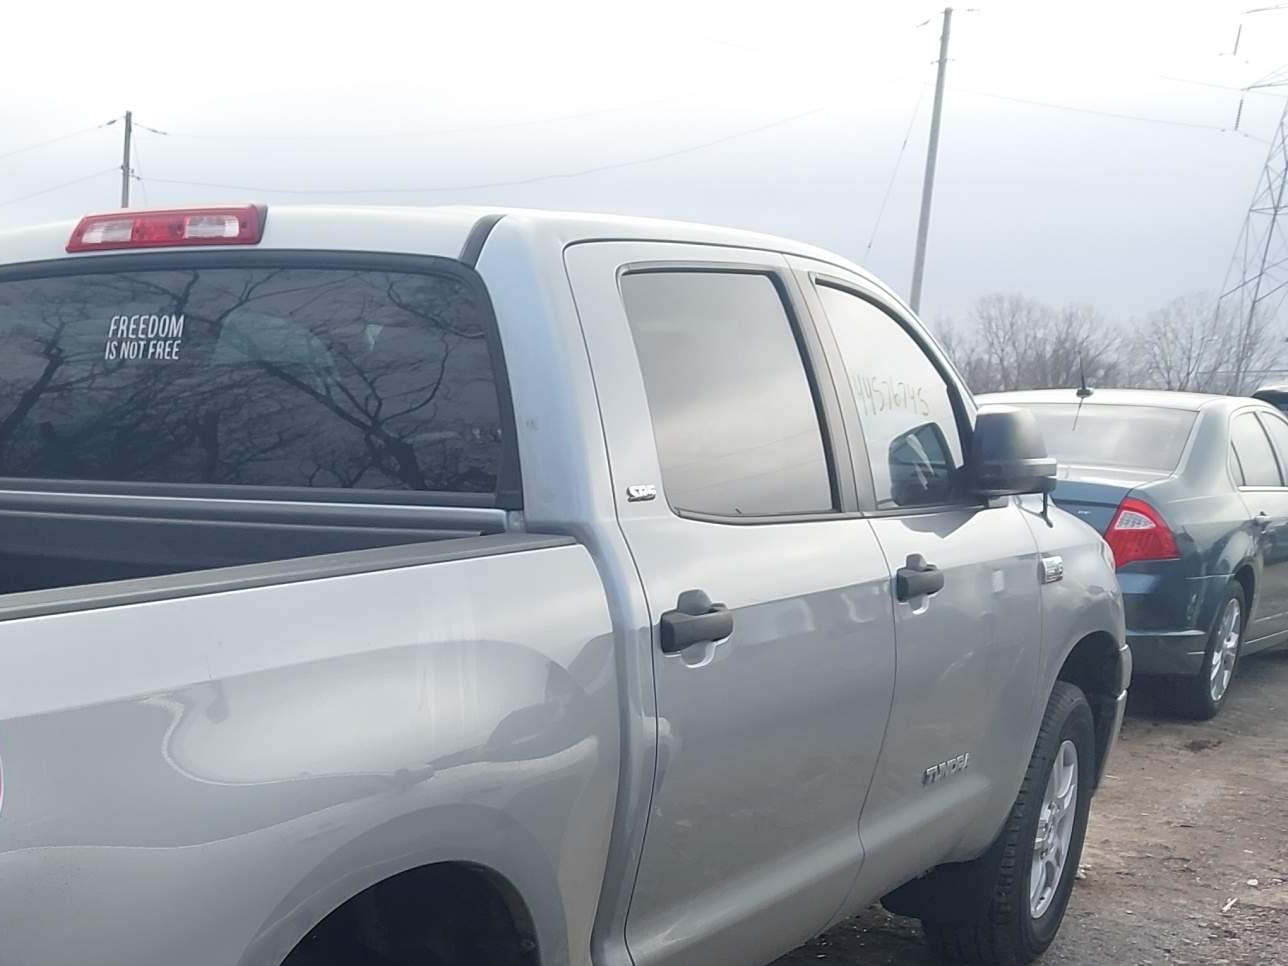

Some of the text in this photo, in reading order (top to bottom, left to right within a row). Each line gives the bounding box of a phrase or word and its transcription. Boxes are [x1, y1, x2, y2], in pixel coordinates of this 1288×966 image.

[108, 314, 184, 338] FREEDOM
[105, 340, 181, 360] IS NOT FREE
